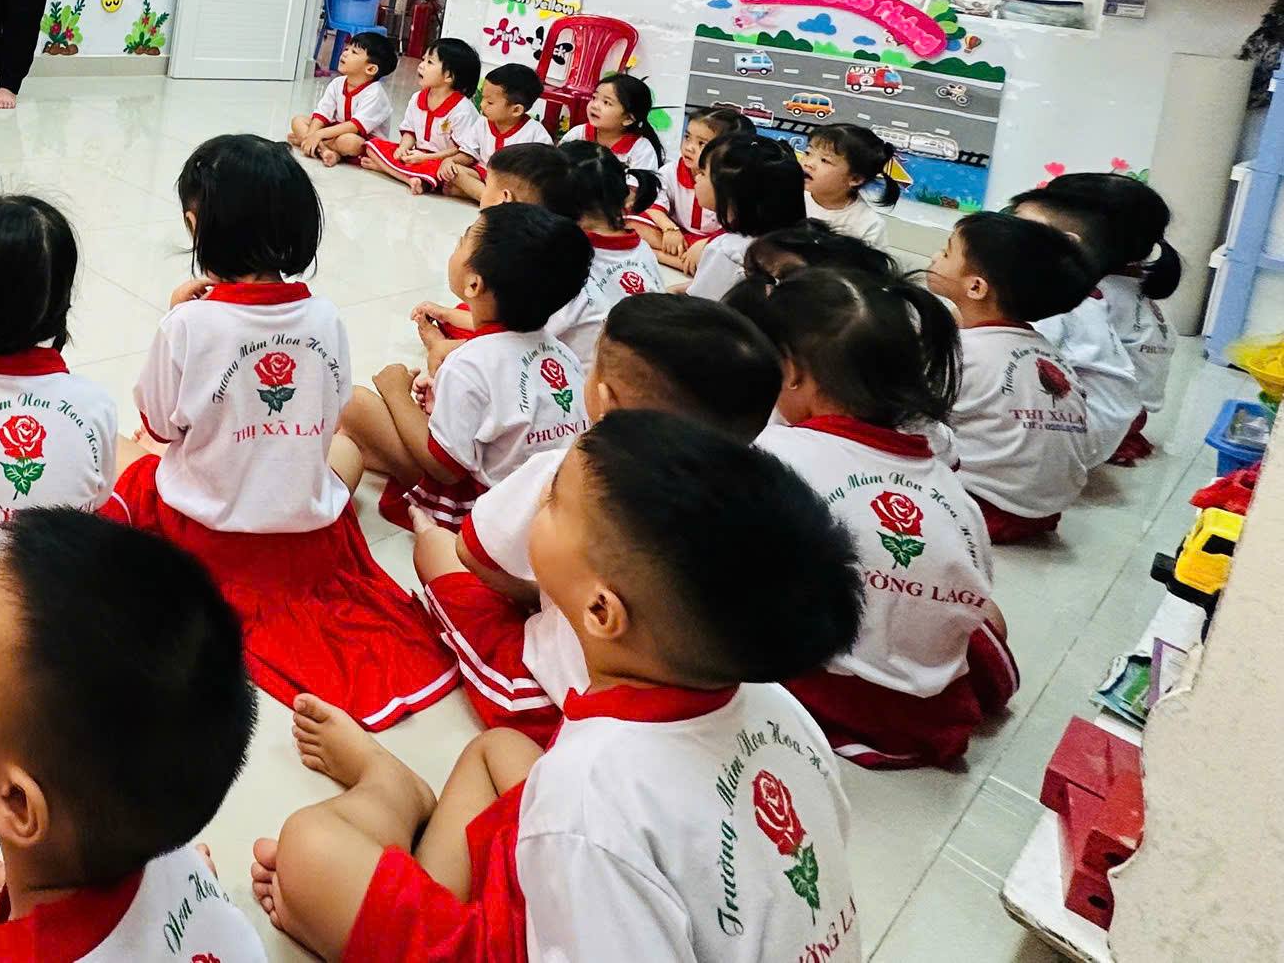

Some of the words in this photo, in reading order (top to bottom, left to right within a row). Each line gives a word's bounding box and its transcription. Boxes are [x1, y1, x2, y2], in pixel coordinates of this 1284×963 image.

[271, 333, 301, 346] Non
[305, 337, 327, 359] Hoa
[17, 392, 51, 409] Non
[57, 399, 84, 429] Hoa
[233, 425, 256, 443] THỊ
[262, 420, 289, 436] XÃ
[847, 472, 884, 491] Mầm
[889, 471, 923, 492] Non
[929, 488, 958, 519] Hoa
[865, 570, 923, 597] ỜNG
[931, 586, 986, 608] LAGI
[737, 729, 767, 757] Non
[767, 720, 803, 755] Hoa
[715, 755, 745, 816] Mầm
[716, 819, 745, 937] Trường
[163, 897, 193, 955] Non
